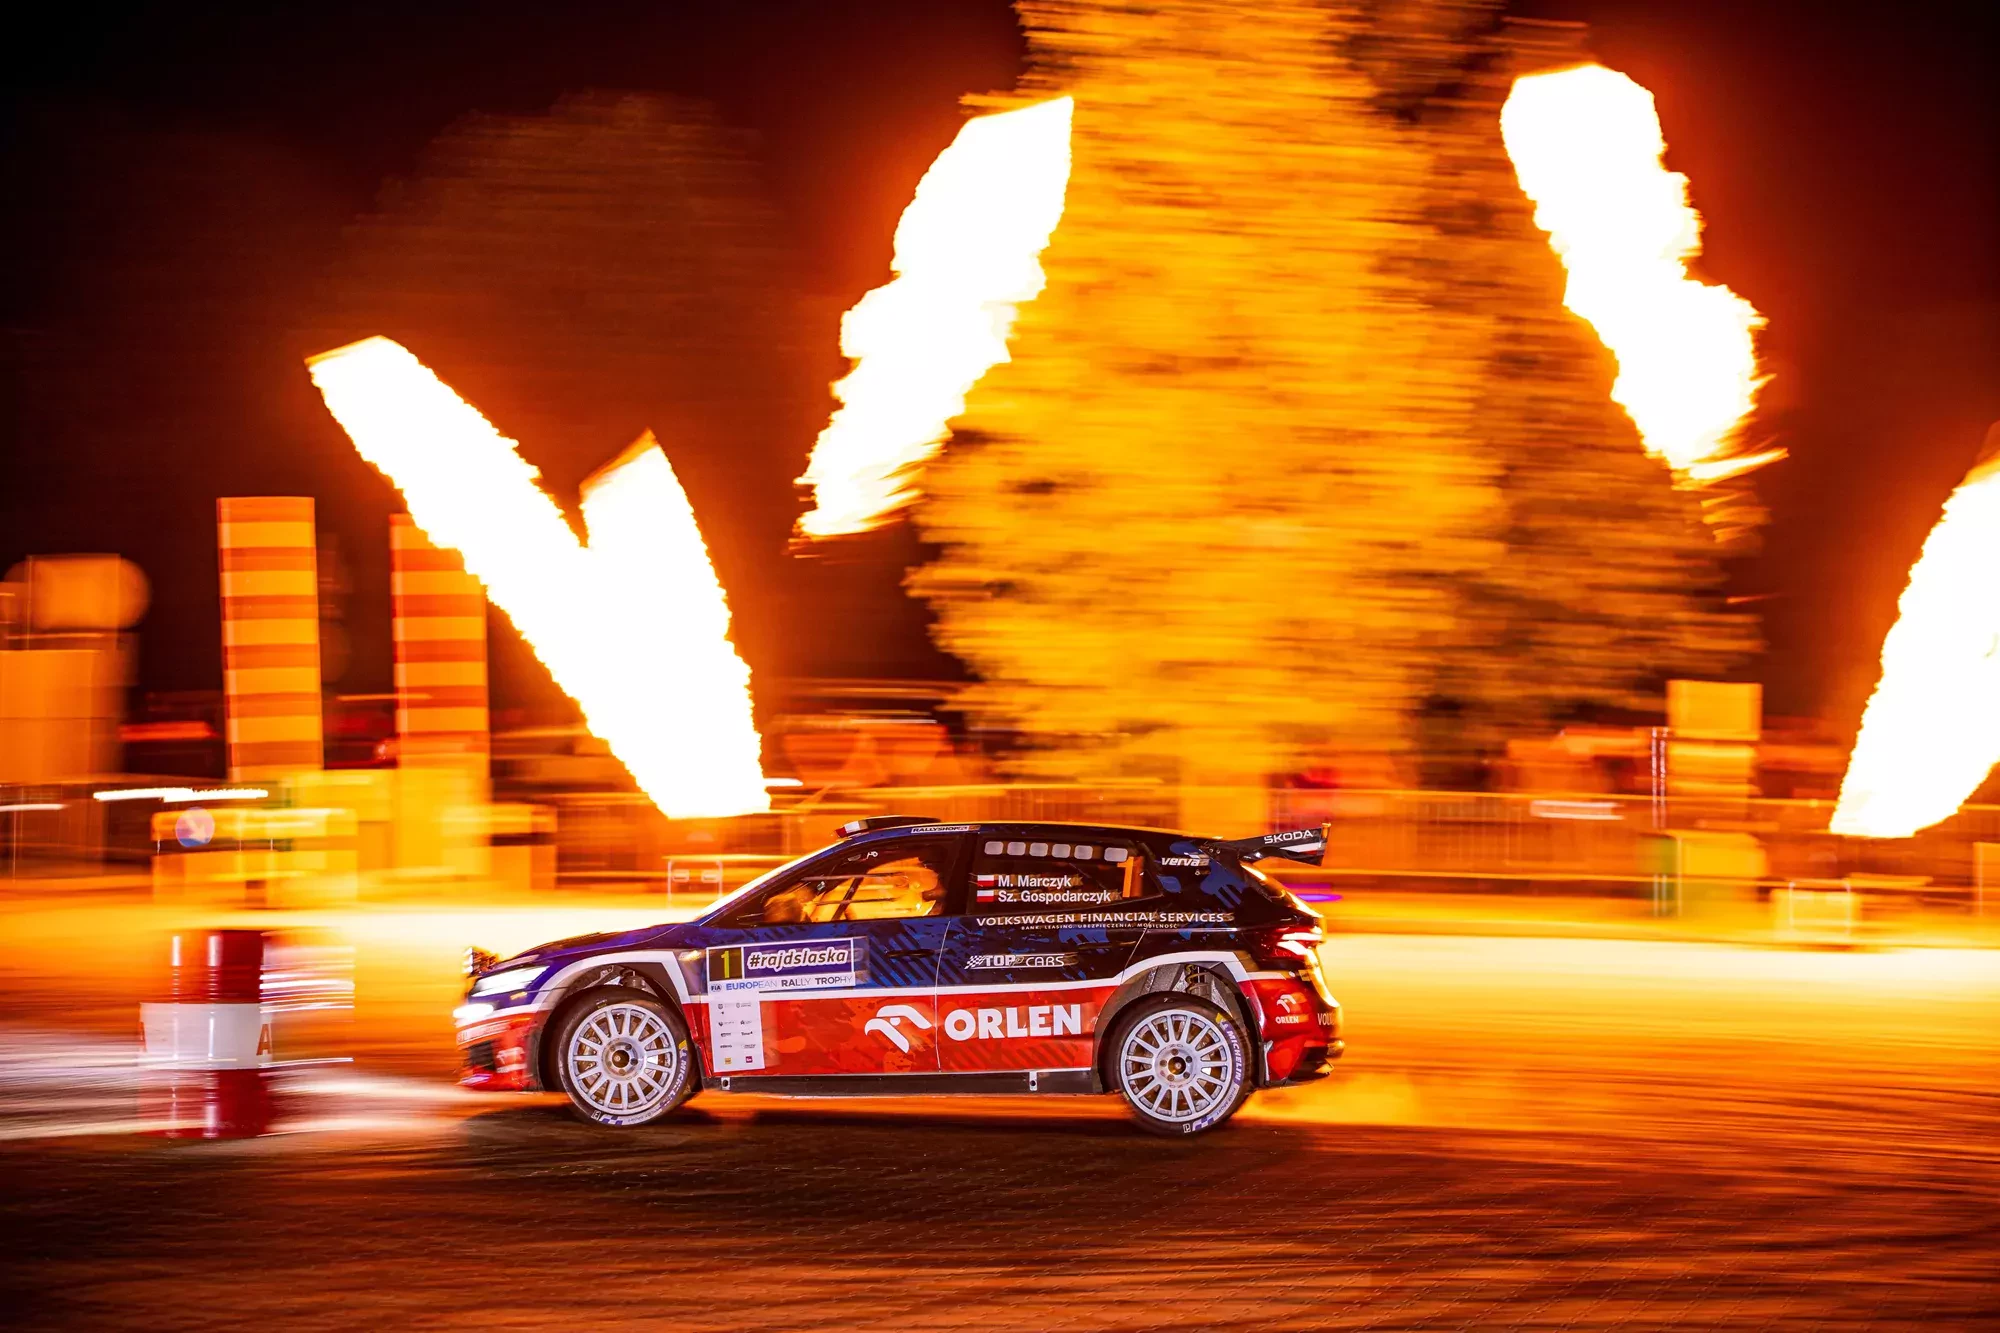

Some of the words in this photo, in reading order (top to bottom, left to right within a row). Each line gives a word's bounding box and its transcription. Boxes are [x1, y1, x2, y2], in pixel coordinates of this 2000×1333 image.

[1161, 857, 1200, 867] verva
[998, 875, 1013, 887] M.
[1018, 875, 1071, 889] Marczyk
[1117, 856, 1134, 897] 1
[998, 890, 1016, 902] Sz.
[1021, 890, 1111, 904] Gospodarczyk
[976, 914, 1074, 926] VOLKSWAGEN
[1080, 913, 1155, 922] FINANCIAL
[1160, 913, 1224, 922] SERVICES
[720, 950, 730, 978] 1
[748, 948, 847, 970] #rajdslaska
[986, 955, 1016, 966] TOP
[1026, 956, 1064, 967] CARS
[726, 980, 777, 991] EUROPEAN
[781, 977, 811, 987] RALLY
[815, 975, 852, 985] TROPHY
[944, 1003, 1081, 1041] ORLEN
[1275, 1016, 1299, 1024] ORLEN
[1227, 1030, 1242, 1081] MICHELIN
